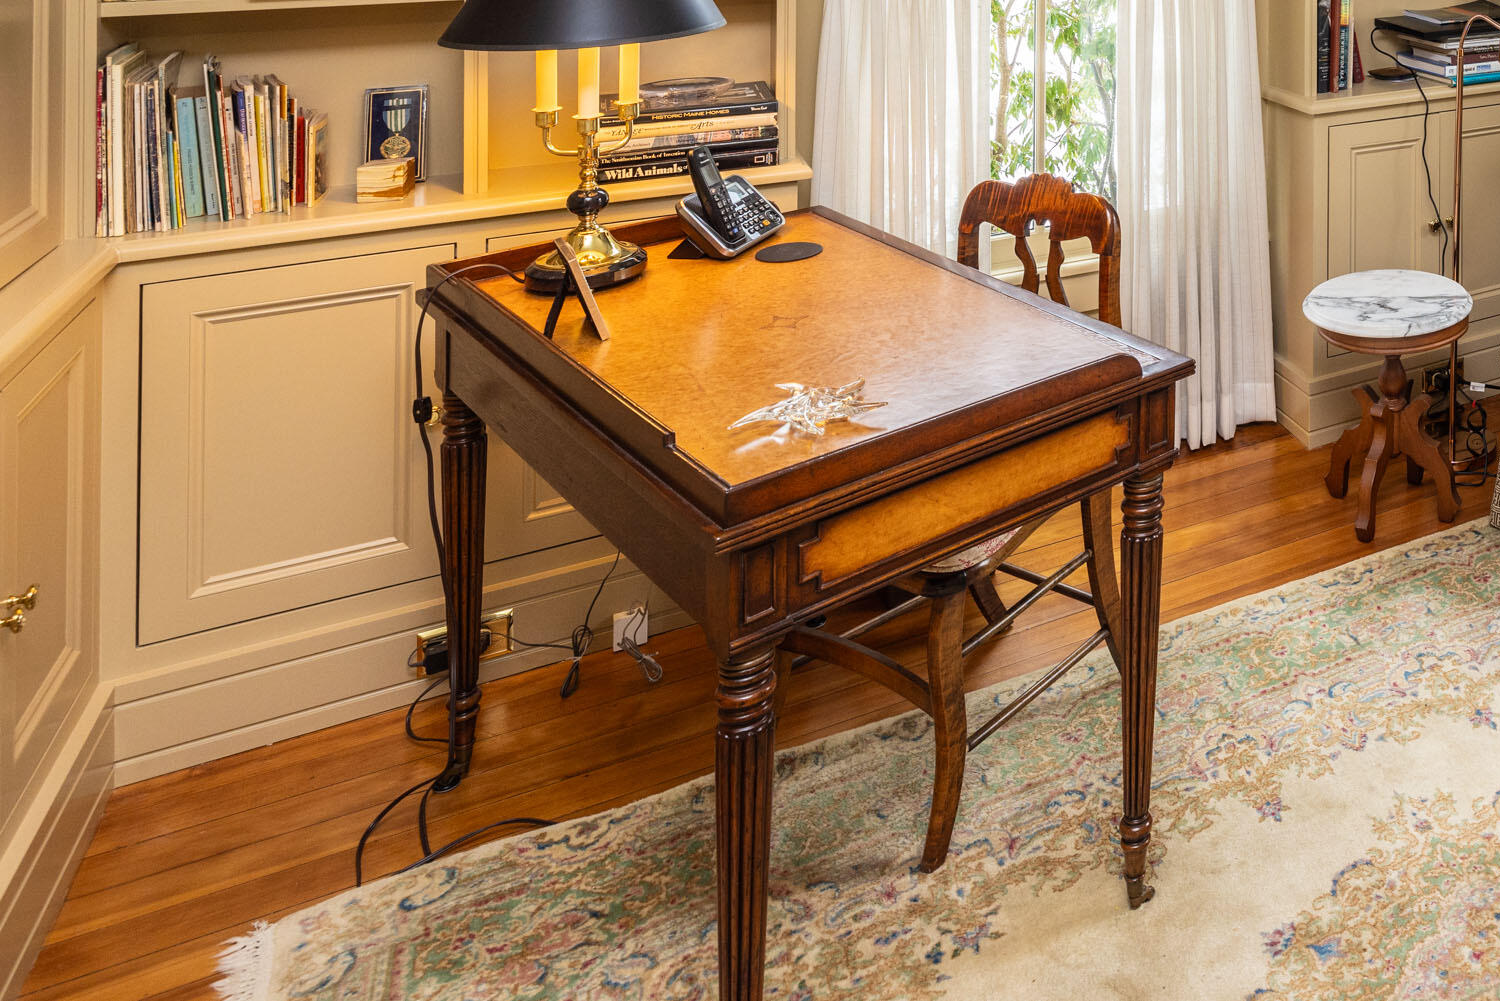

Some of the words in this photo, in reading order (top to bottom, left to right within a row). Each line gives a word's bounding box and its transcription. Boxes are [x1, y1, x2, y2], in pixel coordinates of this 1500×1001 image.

[690, 120, 713, 131] Arts
[611, 155, 643, 164] Smithsonian
[663, 150, 686, 158] Invention
[605, 168, 634, 180] Wild
[634, 163, 683, 177] Animals
